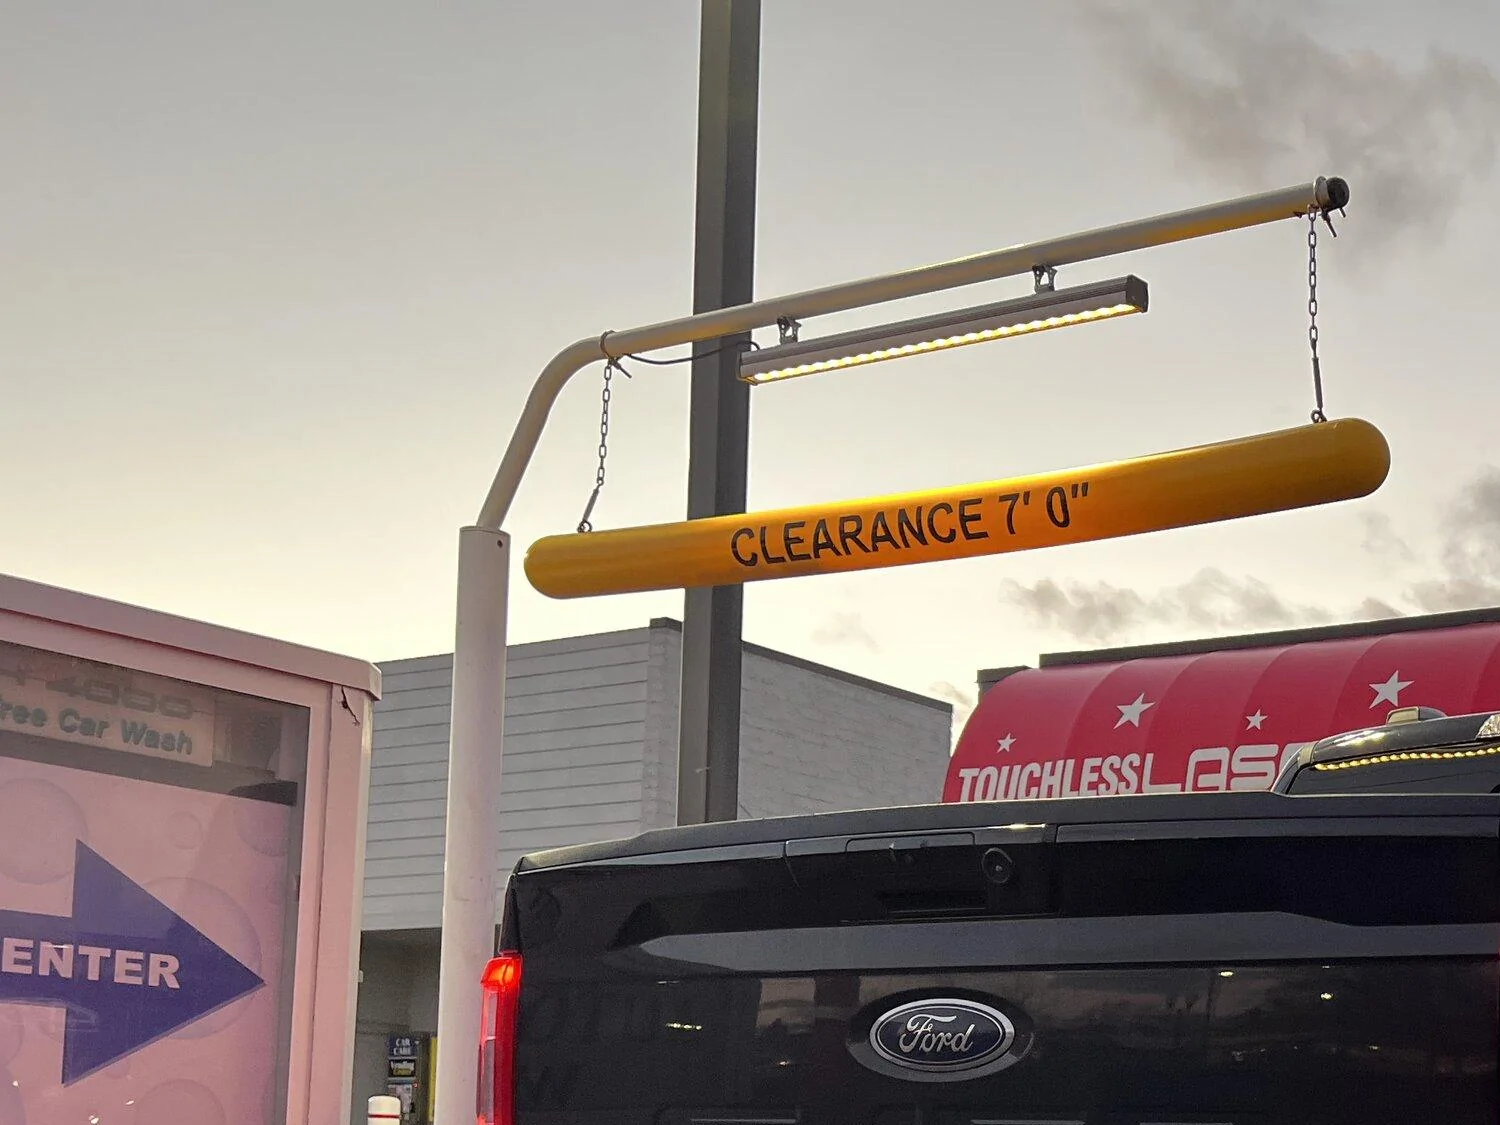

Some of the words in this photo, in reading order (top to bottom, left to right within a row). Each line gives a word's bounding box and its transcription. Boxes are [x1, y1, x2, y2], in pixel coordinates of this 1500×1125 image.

[731, 498, 988, 567] CLEARANCE
[998, 490, 1031, 535] 7'
[1046, 482, 1090, 528] 0"
[58, 707, 110, 739] Car
[120, 719, 193, 756] Wash
[959, 752, 1141, 803] TOUCHLESS
[1143, 742, 1317, 793] LAS
[1, 936, 182, 990] ENTER
[899, 1013, 976, 1054] Ford
